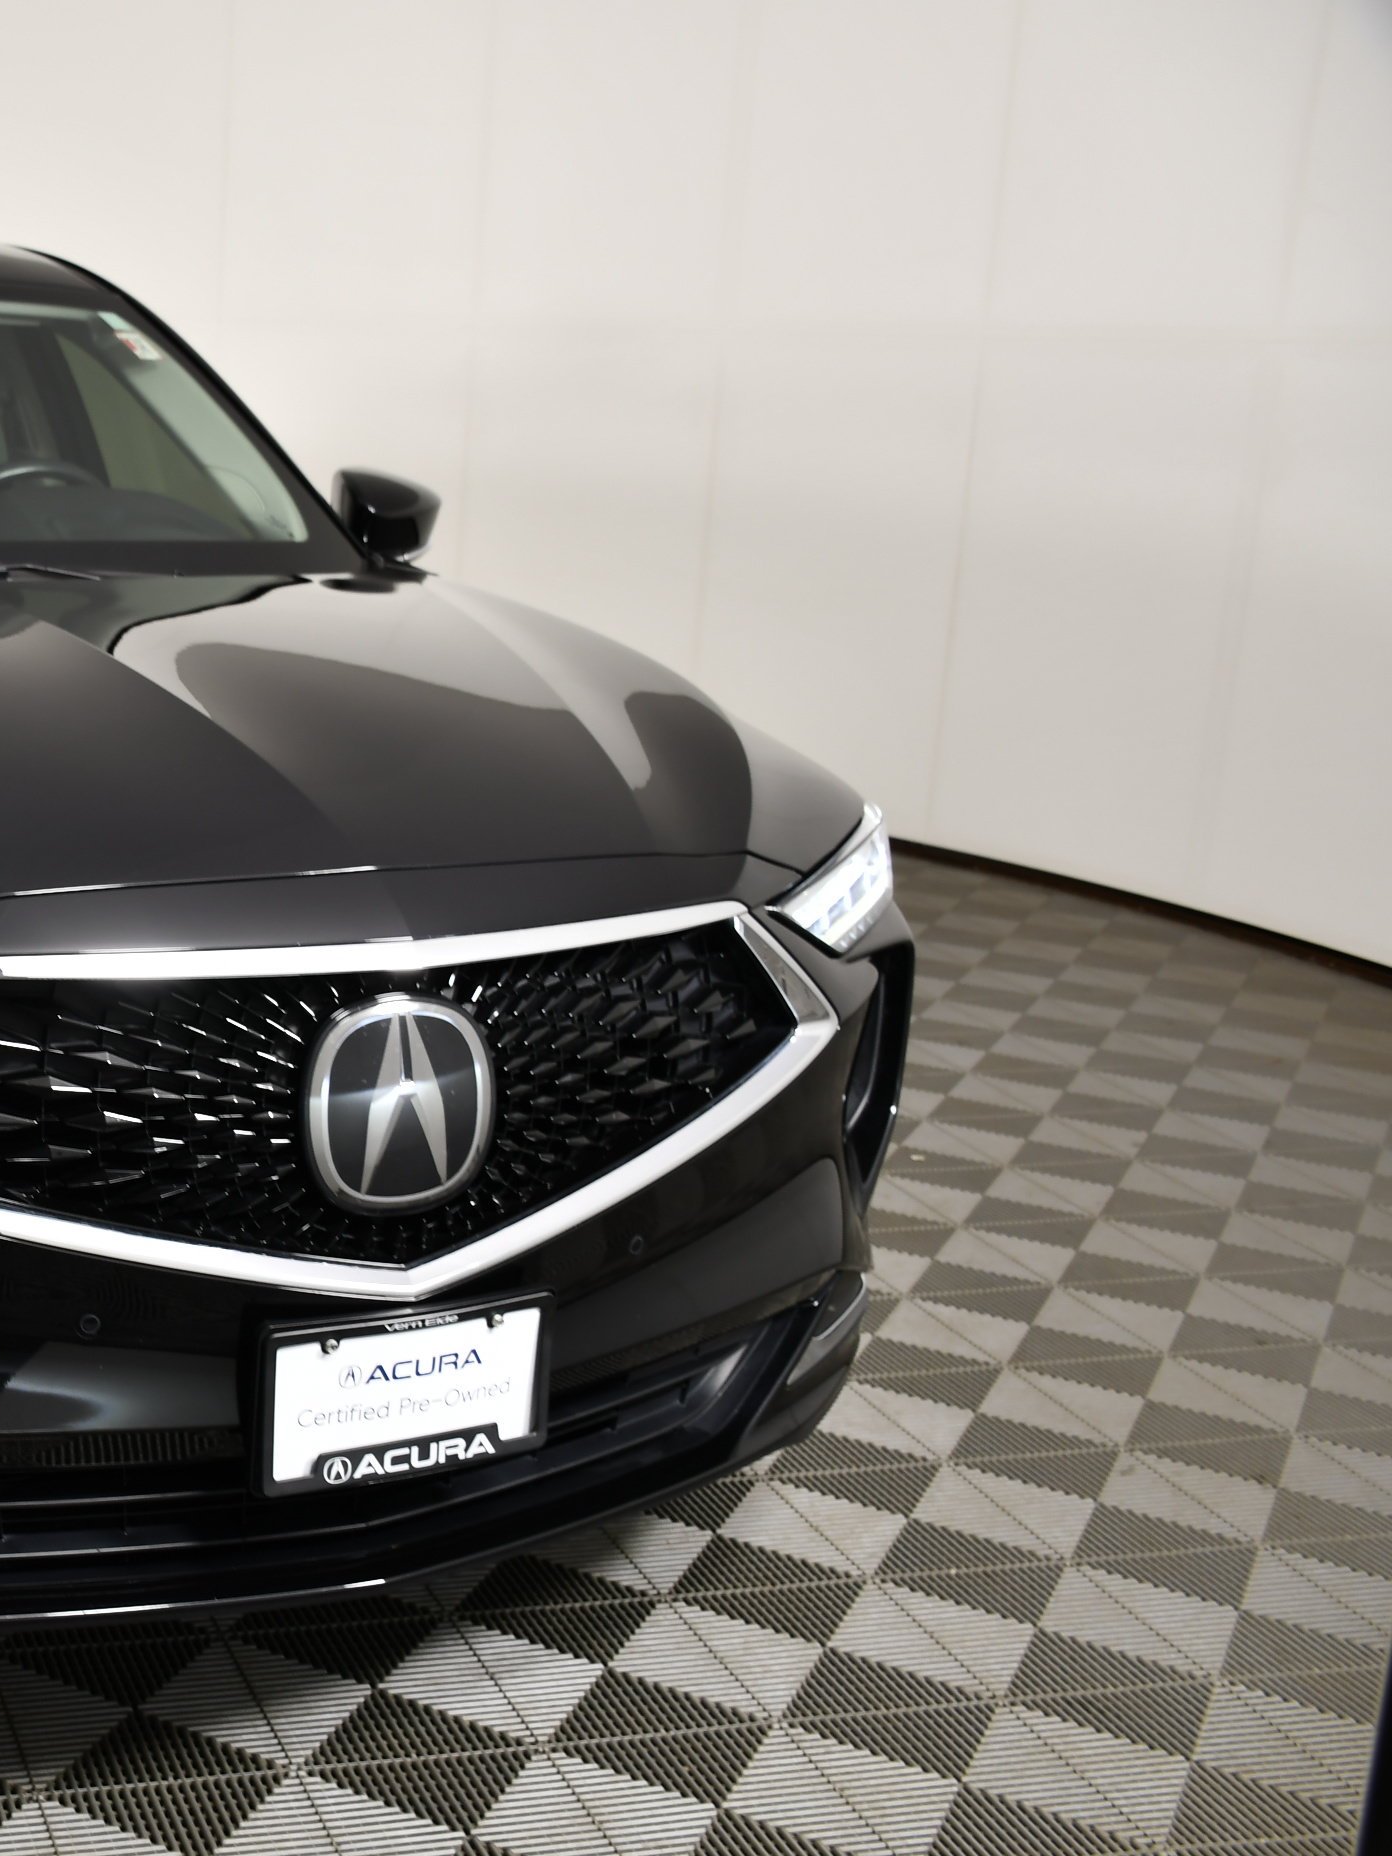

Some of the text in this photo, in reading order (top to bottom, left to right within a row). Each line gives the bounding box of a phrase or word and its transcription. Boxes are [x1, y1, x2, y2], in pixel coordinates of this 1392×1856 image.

[365, 1348, 483, 1384] ACURA
[297, 1377, 511, 1428] Certified Pre-Owned
[353, 1433, 496, 1480] ACURA
